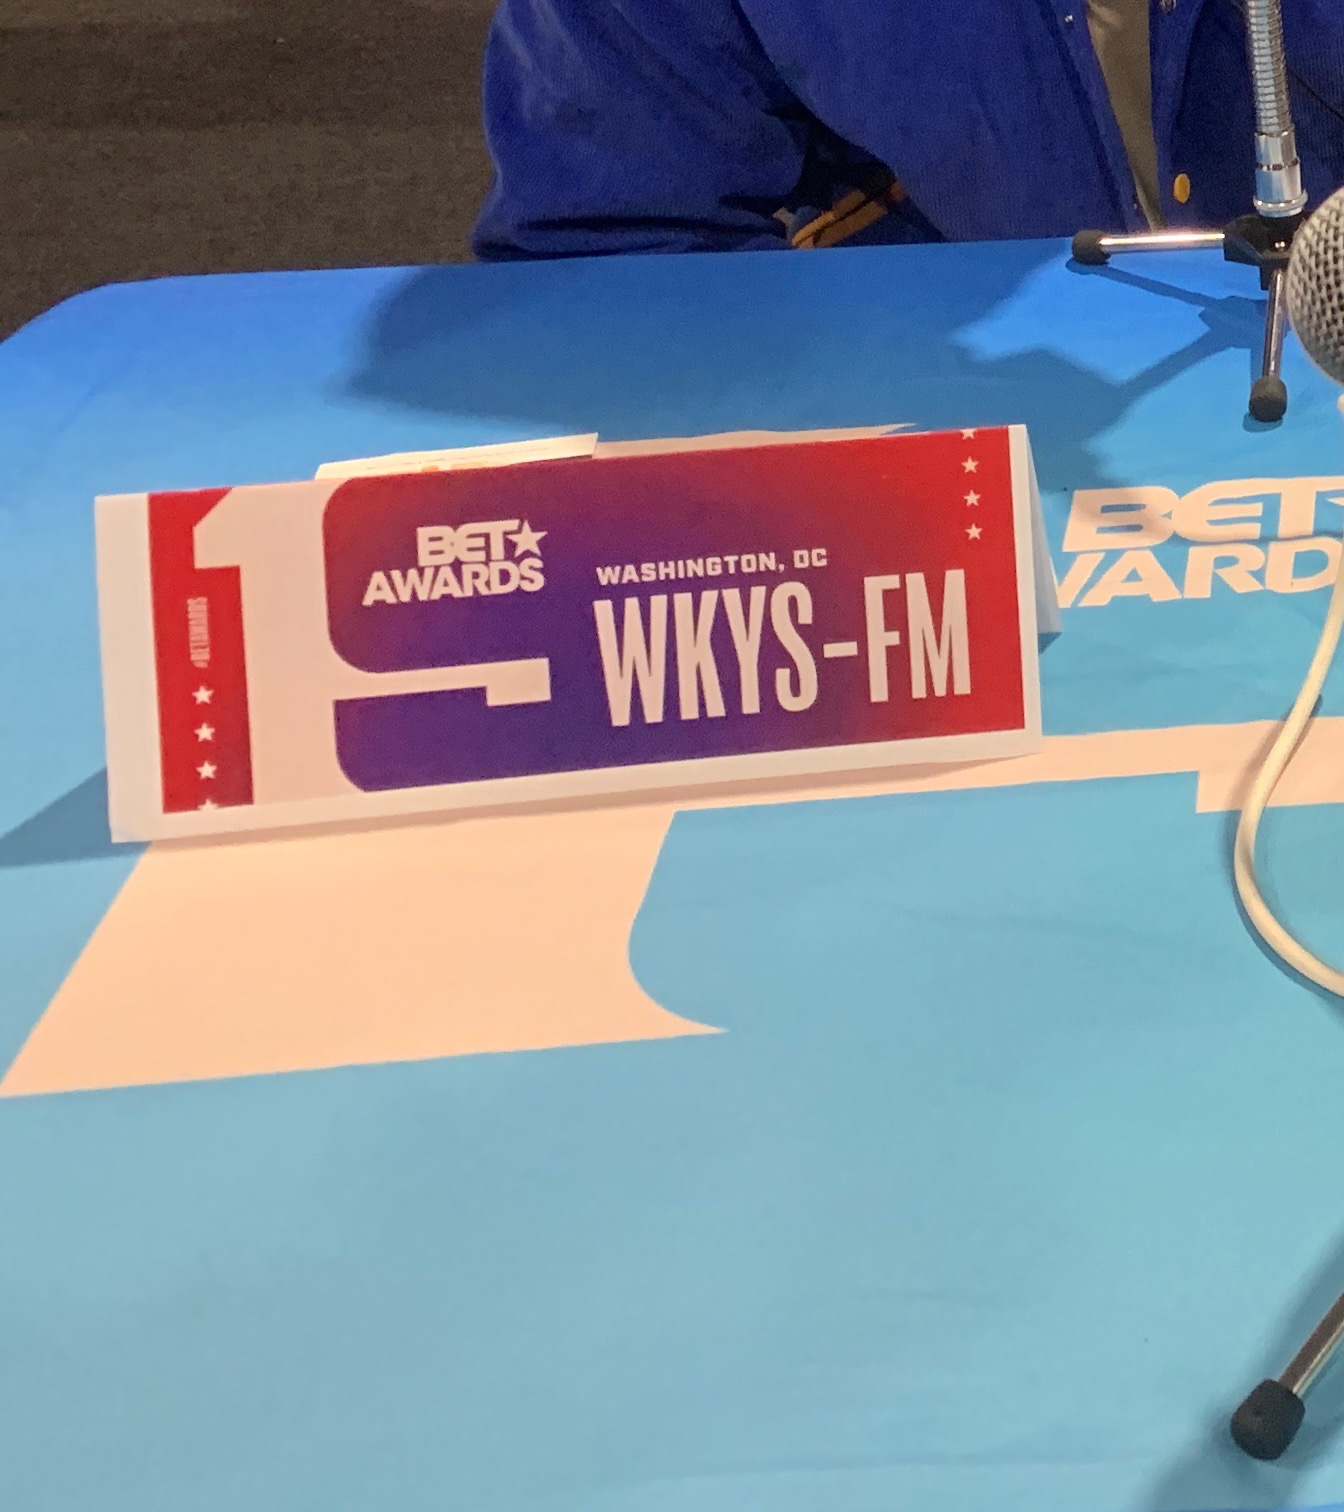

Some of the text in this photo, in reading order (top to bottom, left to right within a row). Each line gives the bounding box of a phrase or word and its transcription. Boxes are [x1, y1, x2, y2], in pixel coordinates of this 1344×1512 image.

[417, 519, 519, 568] BET
[596, 547, 828, 587] WASHINGTON, DC
[362, 557, 545, 607] AWARDS
[592, 567, 972, 729] WKYS-FM
